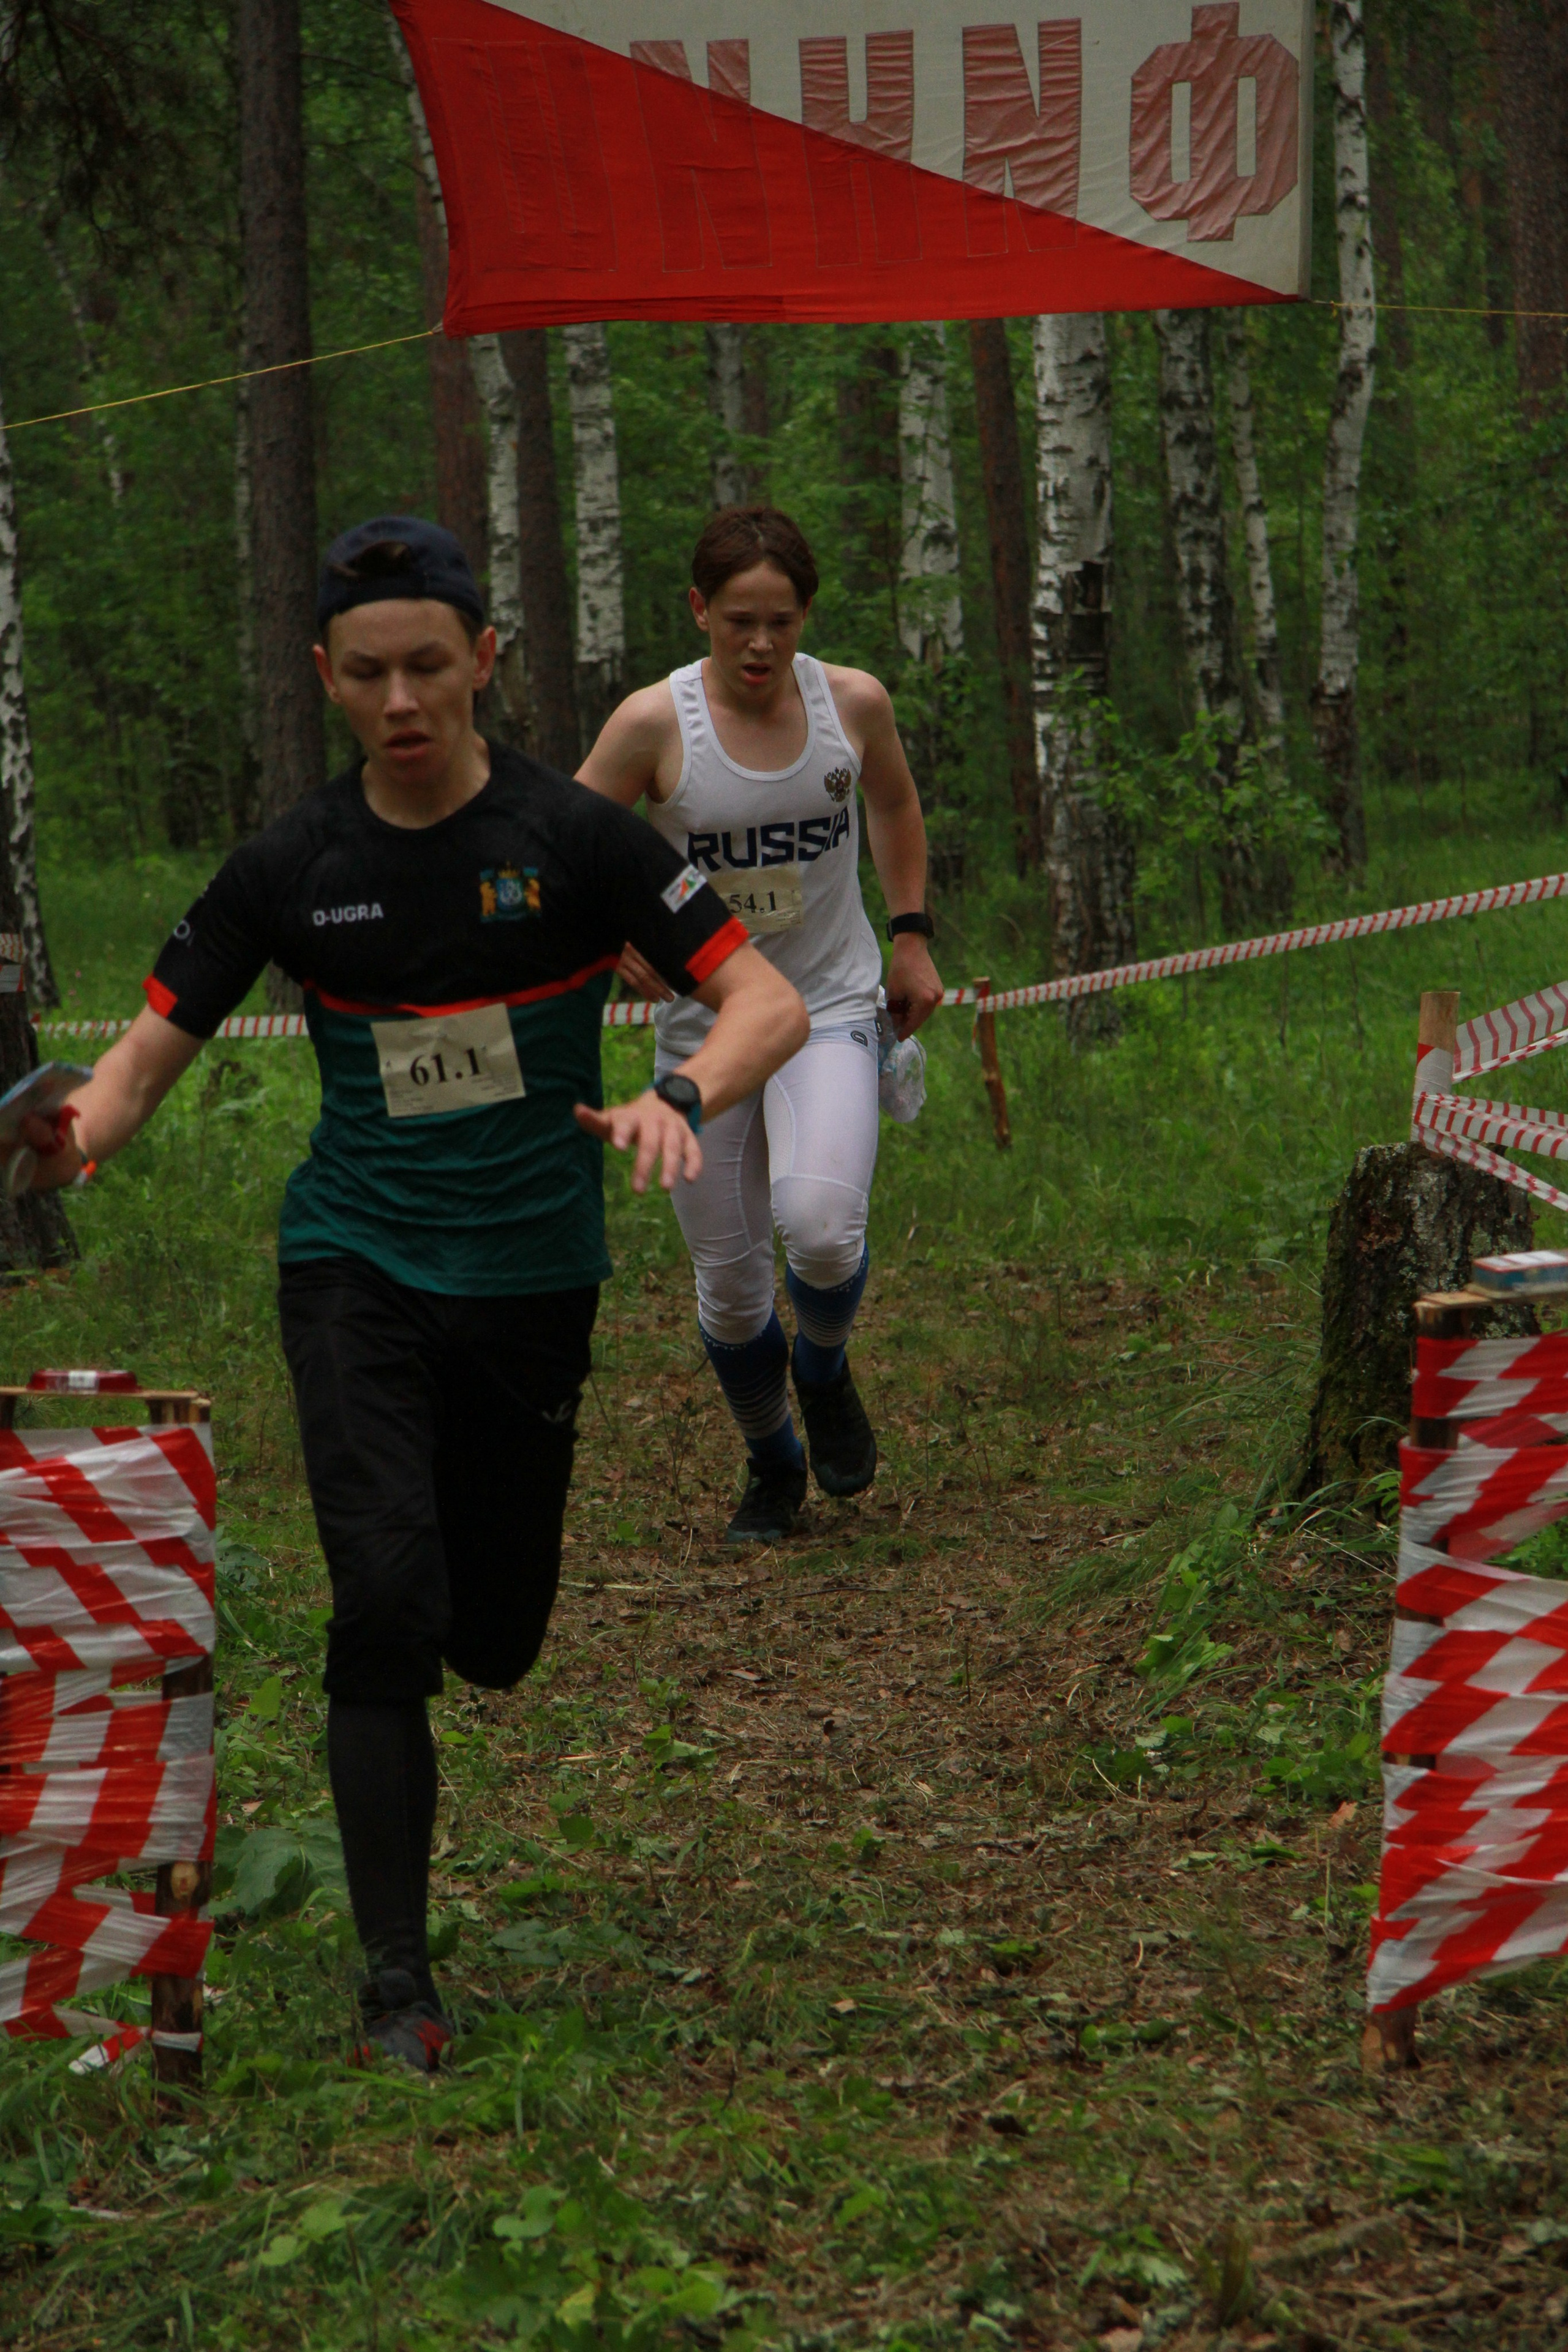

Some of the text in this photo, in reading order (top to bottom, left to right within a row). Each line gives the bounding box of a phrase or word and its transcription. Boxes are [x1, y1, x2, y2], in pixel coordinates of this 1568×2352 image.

[688, 806, 850, 872] RUSSIA
[312, 903, 384, 927] O-UGRA
[729, 891, 777, 914] 54.1
[410, 1047, 480, 1087] 61.1
